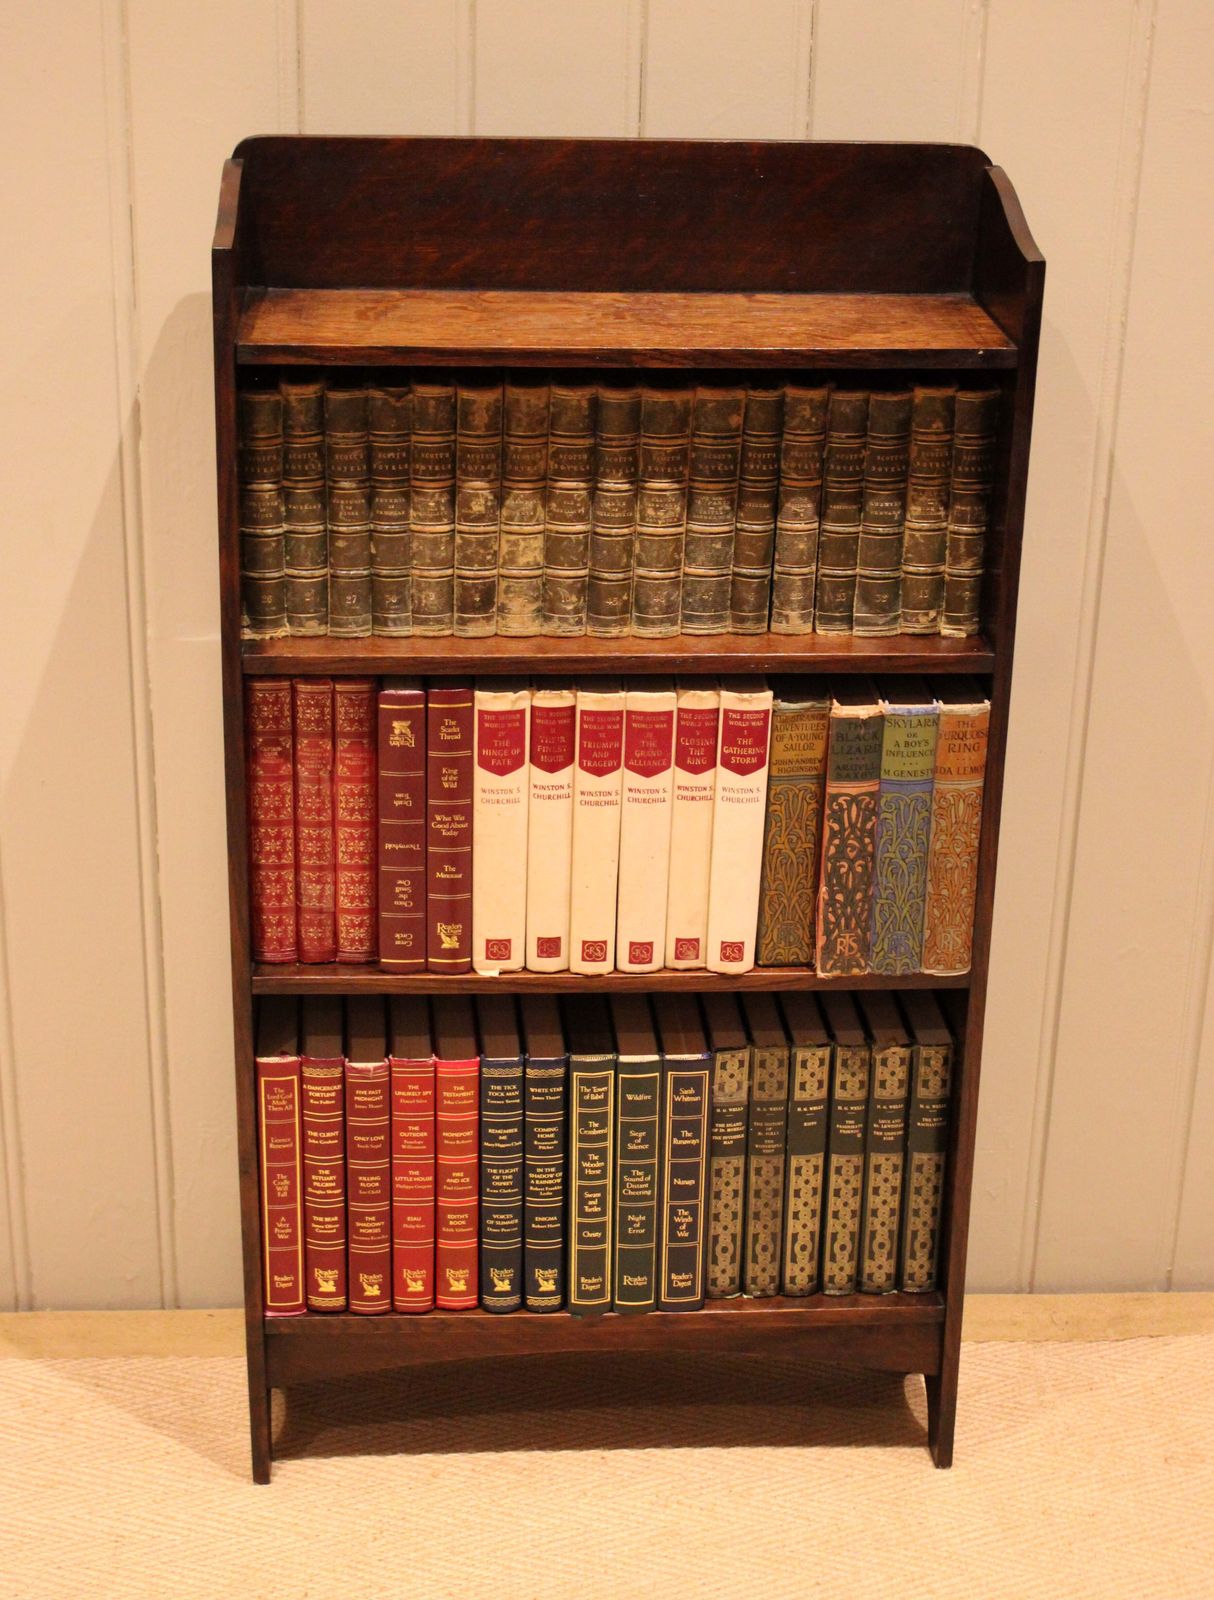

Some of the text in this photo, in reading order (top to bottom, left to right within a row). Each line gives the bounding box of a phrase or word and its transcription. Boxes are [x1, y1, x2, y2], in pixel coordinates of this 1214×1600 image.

[775, 723, 825, 732] ADVENTURES
[887, 719, 938, 728] SKYLARK
[783, 743, 815, 751] SAILOR
[904, 739, 929, 748] BOY'S
[948, 743, 980, 753] RING
[724, 746, 765, 754] GATHERING
[687, 757, 707, 765] RING
